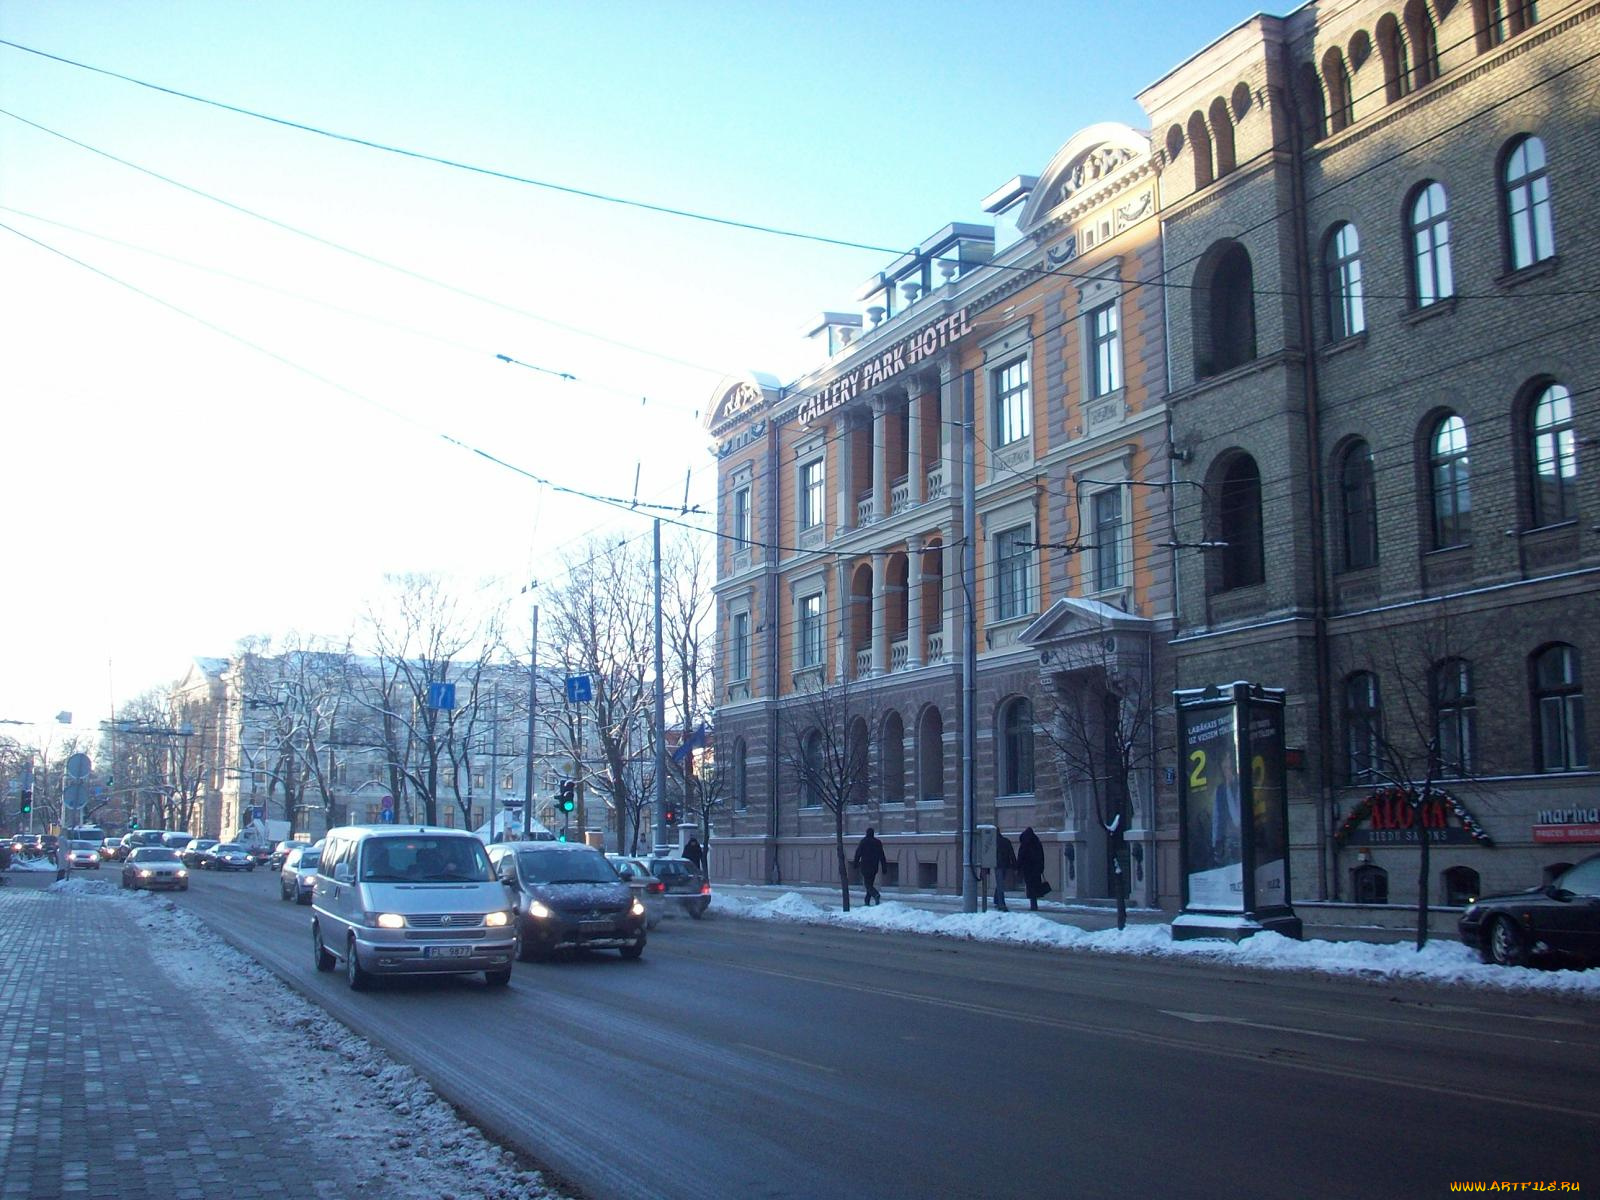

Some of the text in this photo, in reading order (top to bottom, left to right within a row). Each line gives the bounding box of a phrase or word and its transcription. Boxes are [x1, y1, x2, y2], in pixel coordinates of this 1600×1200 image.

[797, 309, 973, 426] GALLERY PARK HOTEL
[1189, 750, 1207, 788] 2
